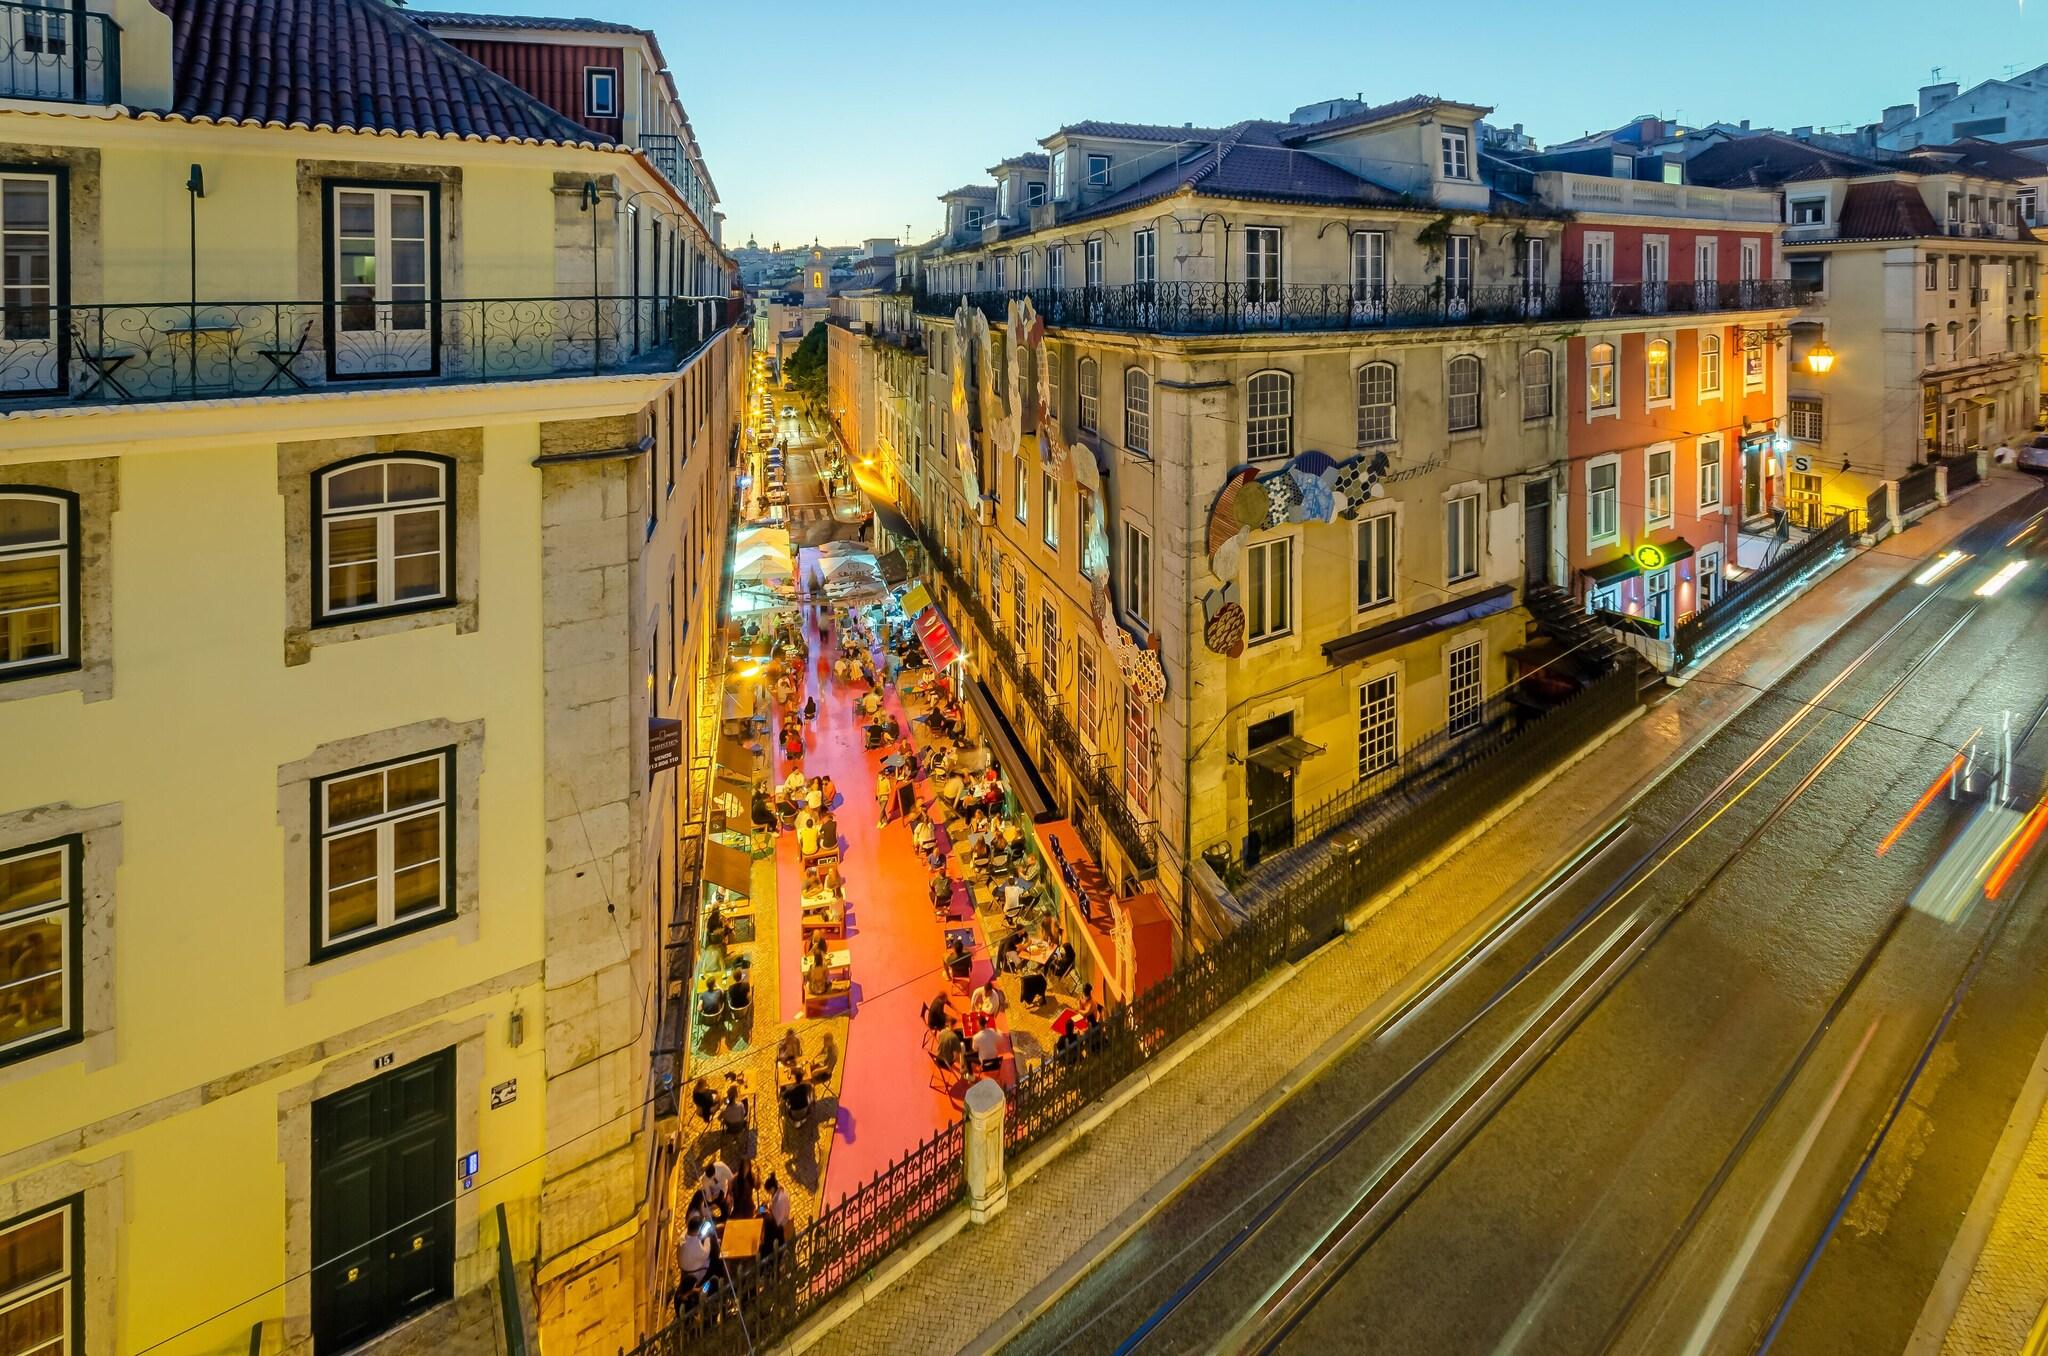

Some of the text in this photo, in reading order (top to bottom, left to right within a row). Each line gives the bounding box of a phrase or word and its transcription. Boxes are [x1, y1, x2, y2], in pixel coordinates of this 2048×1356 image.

[1795, 457, 1808, 471] S
[654, 752, 672, 762] VENDE
[378, 1055, 390, 1068] 15
